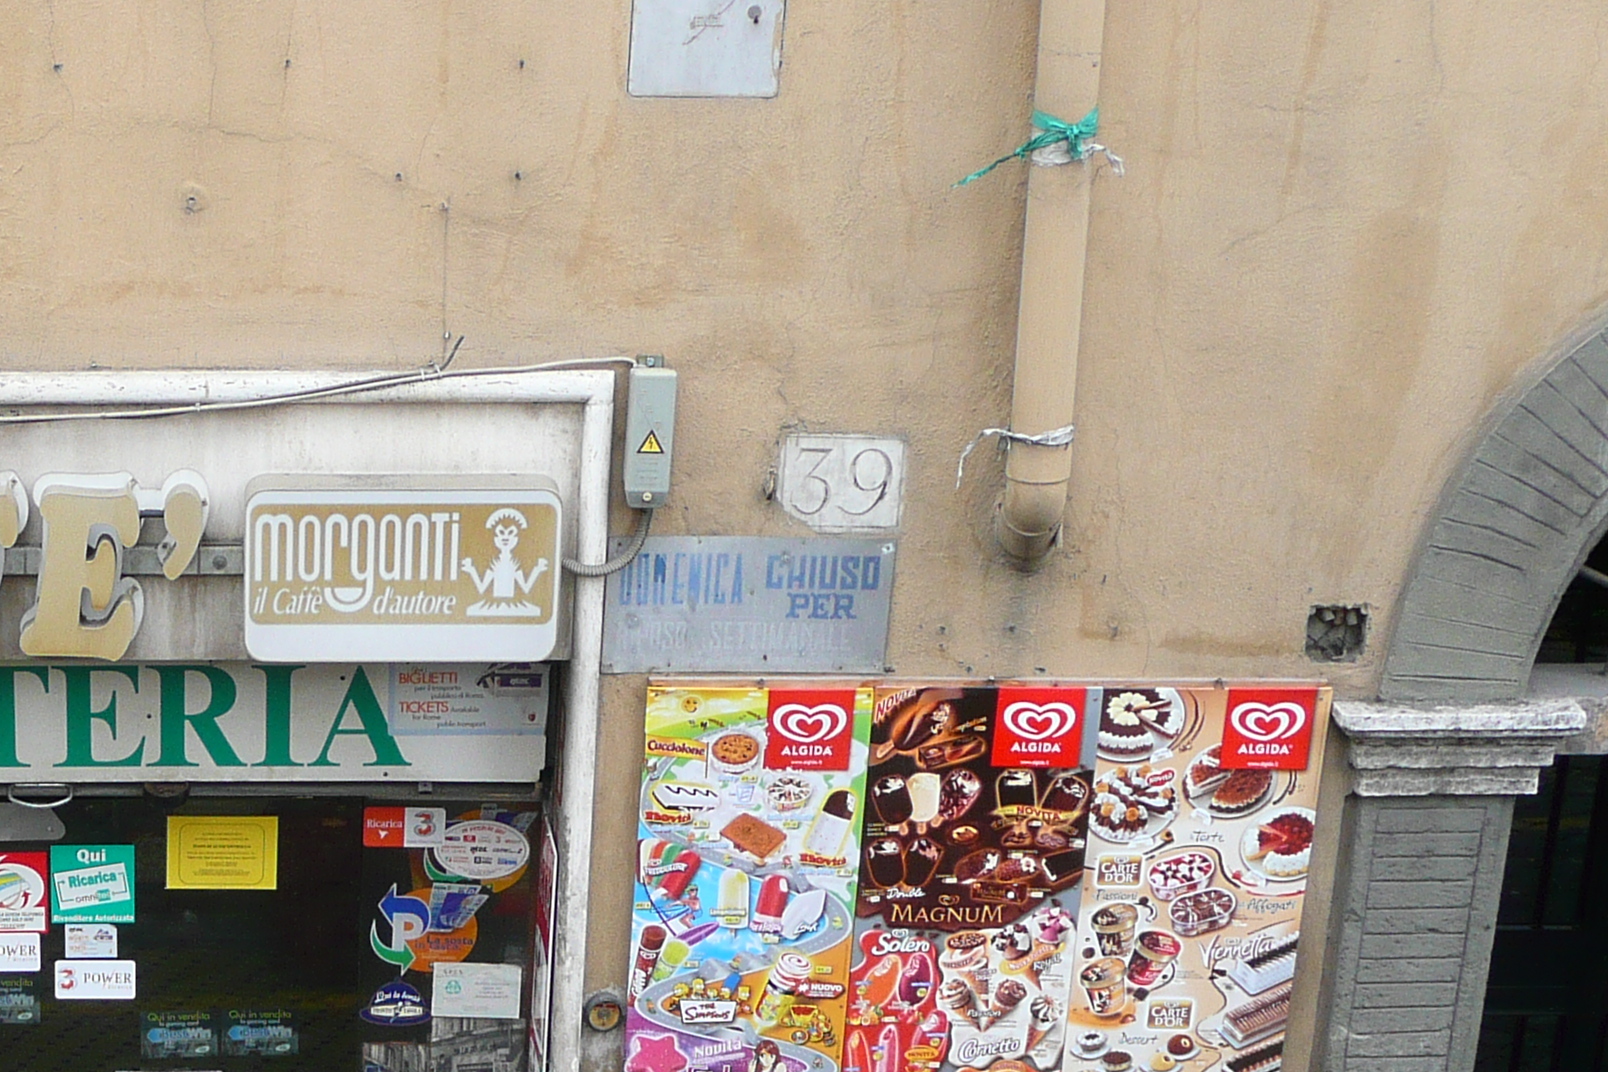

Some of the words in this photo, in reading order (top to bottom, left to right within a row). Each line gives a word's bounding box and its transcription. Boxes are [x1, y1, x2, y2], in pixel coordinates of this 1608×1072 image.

[791, 448, 893, 516] 39
[253, 511, 461, 613] morganti
[619, 552, 742, 605] DOMENICA
[765, 555, 881, 590] CHIUSO
[252, 588, 265, 614] il
[272, 585, 323, 616] Caffè
[373, 585, 457, 616] d'autore
[785, 593, 857, 619] PER
[399, 672, 458, 684] BIGLIETTI
[399, 701, 449, 713] TICKETS
[647, 740, 705, 756] Cucciolone
[781, 745, 833, 756] ALGIDA
[1011, 742, 1061, 753] ALGIDA
[1238, 744, 1289, 755] ALGIDA
[366, 818, 403, 829] Ricarica
[77, 849, 106, 863] Qui
[1100, 863, 1138, 874] CARTE
[68, 872, 117, 888] Ricarica
[1104, 873, 1133, 884] D'OR
[886, 887, 926, 899] Double
[95, 914, 134, 922] Autorizzato
[892, 904, 1006, 923] MAGNUM
[392, 913, 424, 951] P
[427, 935, 441, 944] La
[445, 937, 474, 946] sosta
[871, 935, 930, 955] Solero
[1200, 933, 1276, 969] Viennetta
[0, 977, 33, 986] vendita
[58, 969, 76, 990] 3
[83, 972, 132, 984] POWER
[810, 984, 842, 992] NUOVO
[147, 1013, 165, 1021] Qui
[178, 1011, 210, 1020] vendita
[229, 1010, 245, 1019] Qui
[248, 1010, 257, 1018] in
[259, 1009, 291, 1019] vendita
[1151, 1006, 1188, 1018] CARTE
[1154, 1016, 1184, 1027] D'OR
[1119, 1032, 1158, 1045] Dessert
[958, 1038, 1020, 1063] Cornetto
